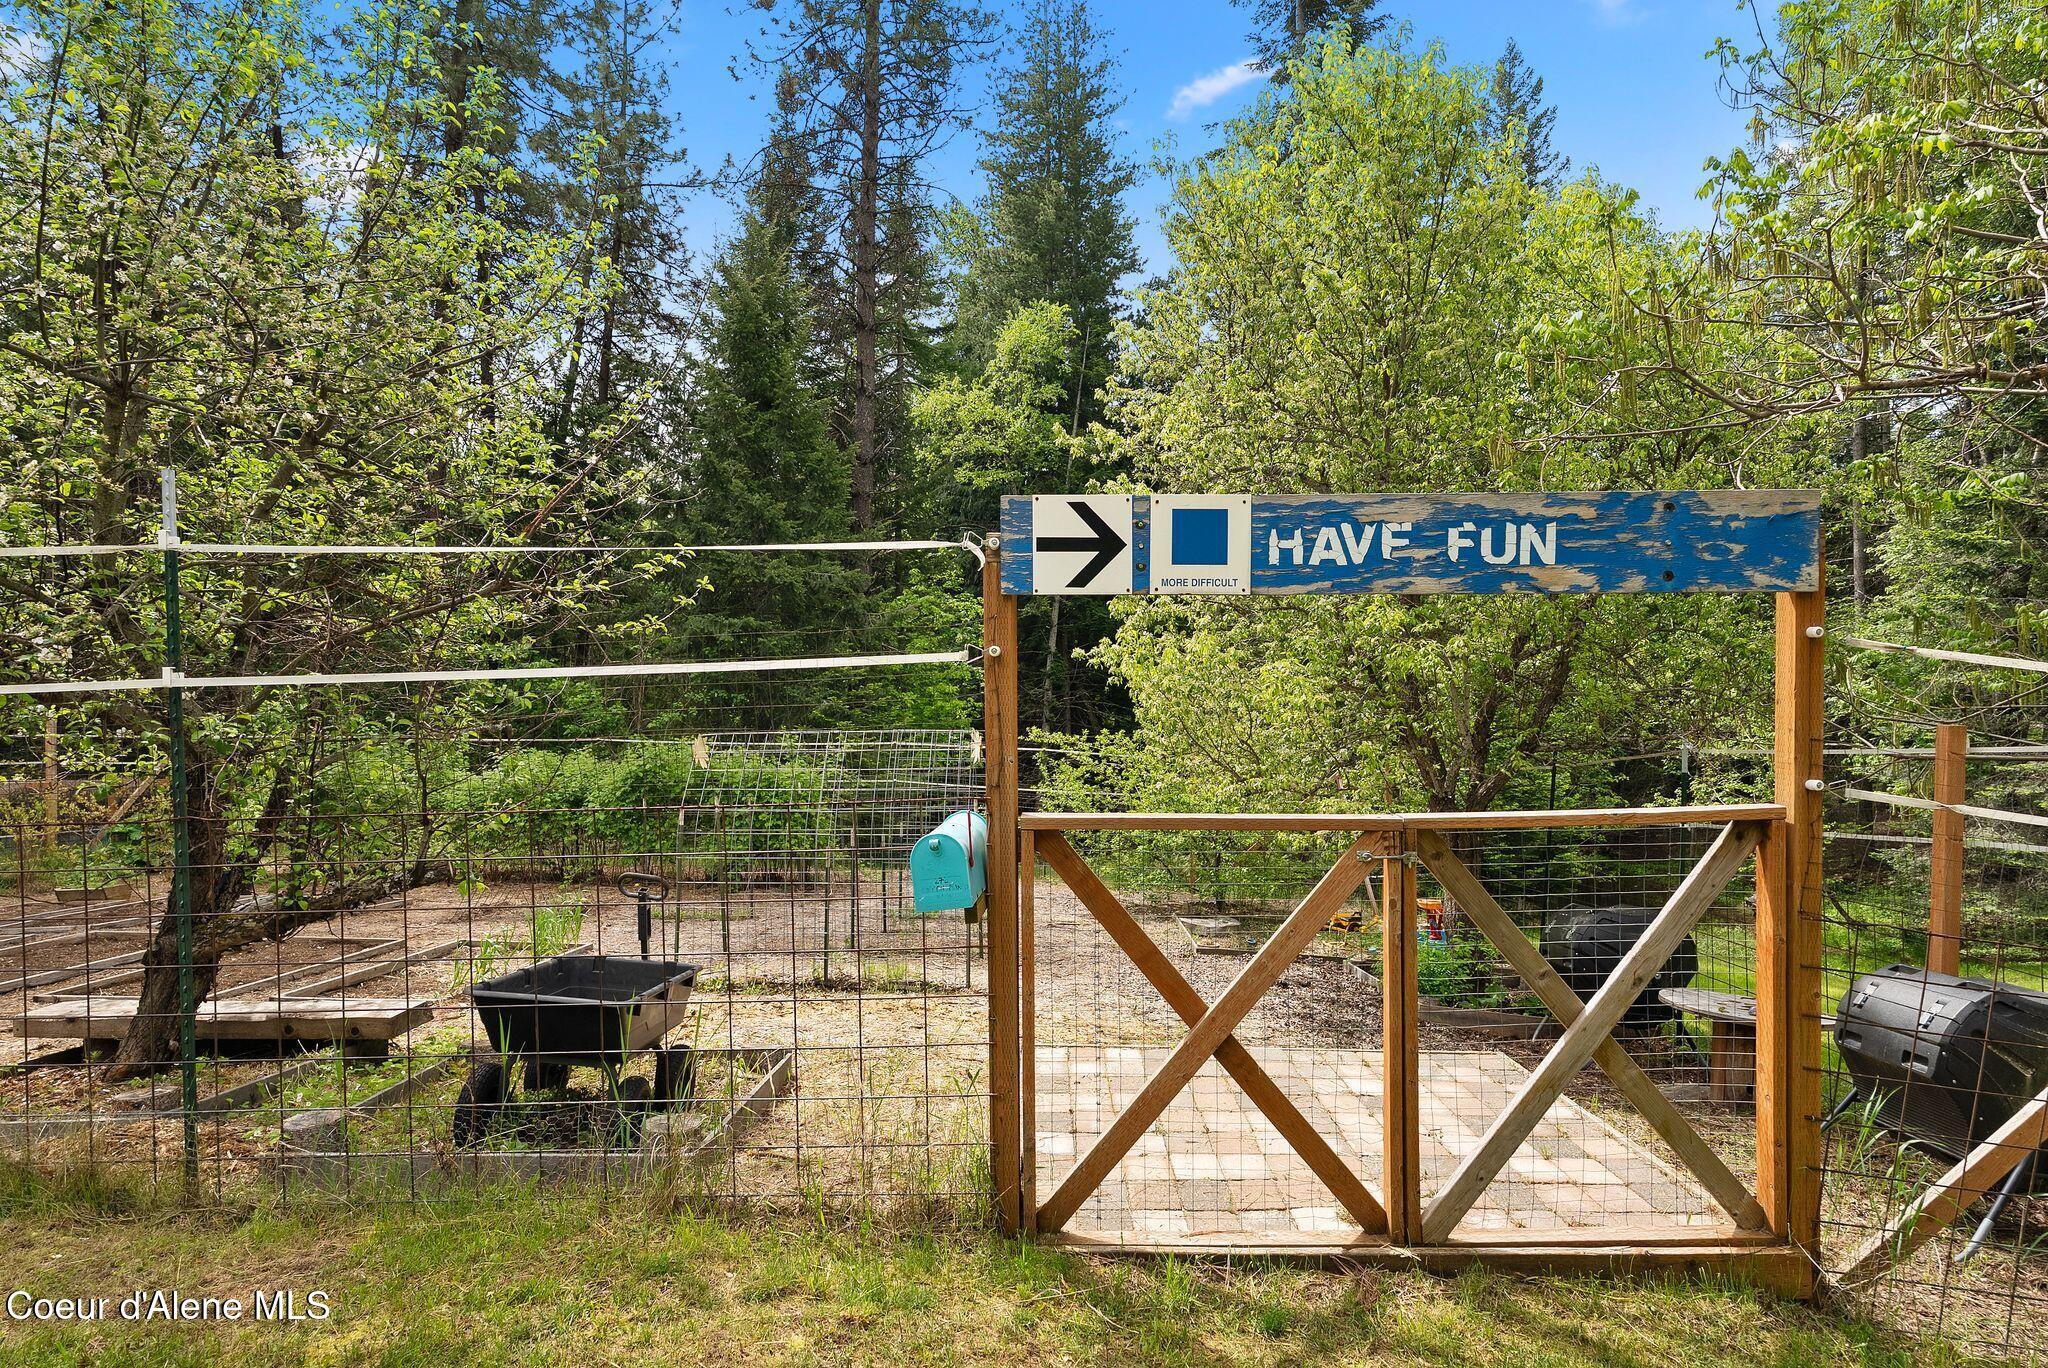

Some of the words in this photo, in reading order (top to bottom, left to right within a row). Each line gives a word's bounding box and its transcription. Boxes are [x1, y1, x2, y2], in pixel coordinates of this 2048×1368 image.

[1268, 522, 1412, 565] HAVE
[1448, 522, 1557, 565] FUN
[1161, 578, 1188, 587] MORE
[1191, 578, 1238, 587] DIFFICULT
